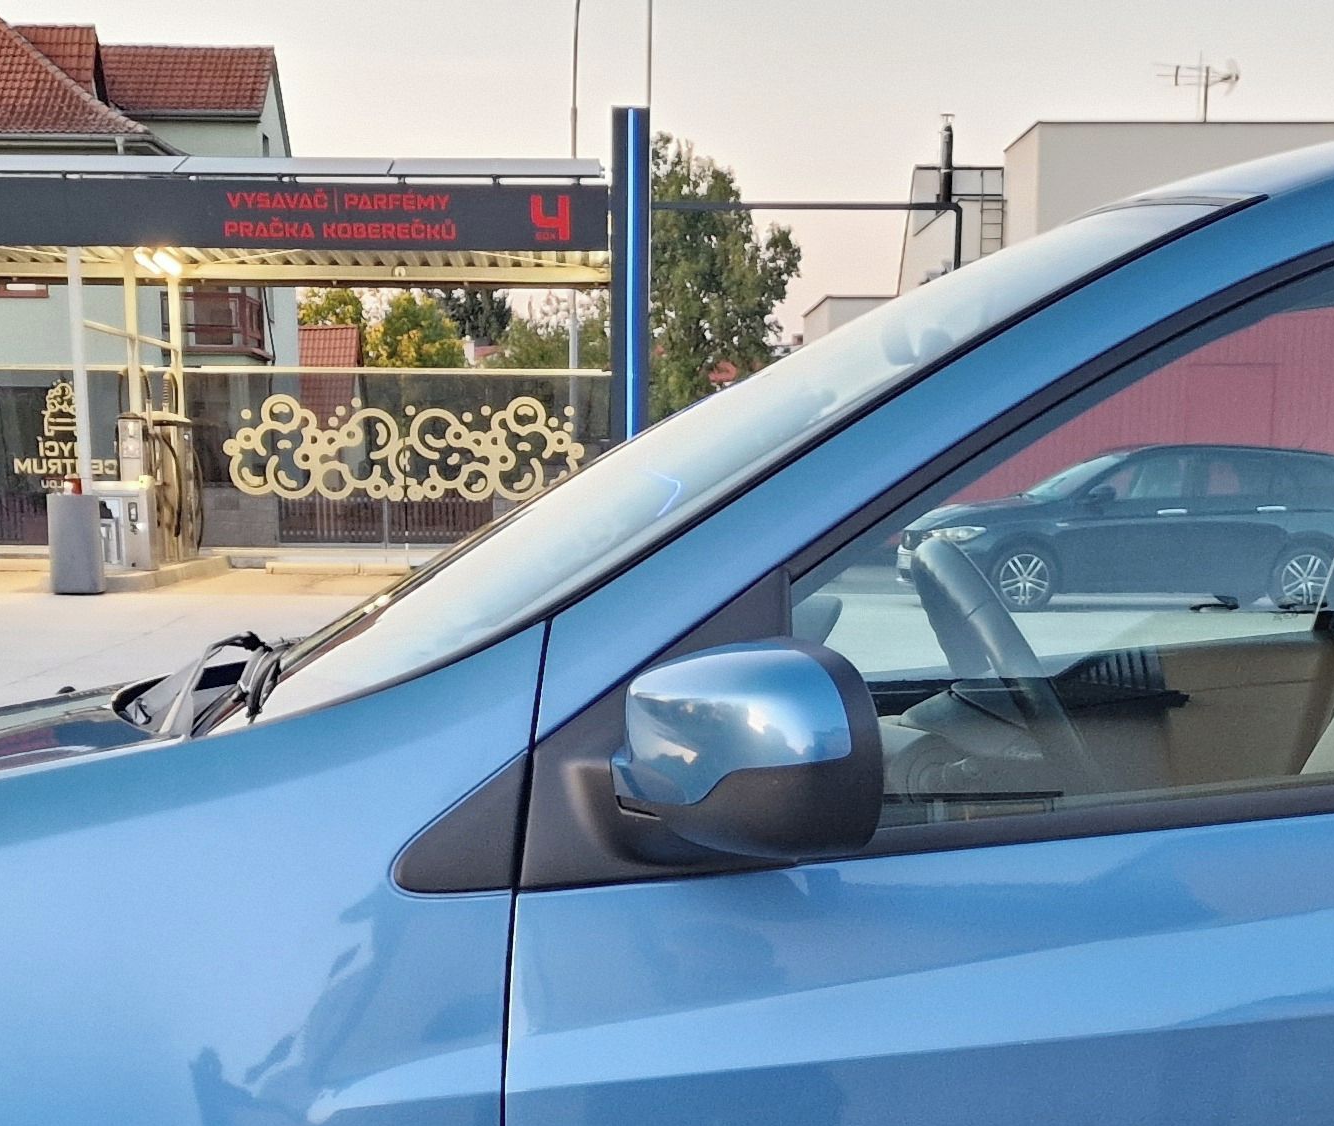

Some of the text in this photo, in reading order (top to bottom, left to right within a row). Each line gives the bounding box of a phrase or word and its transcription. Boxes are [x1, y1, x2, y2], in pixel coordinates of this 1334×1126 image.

[227, 188, 451, 212] VYSAVAČ PARFÉMY
[224, 216, 457, 240] PRAČKA KOBEREČKŮ
[529, 194, 571, 242] 4
